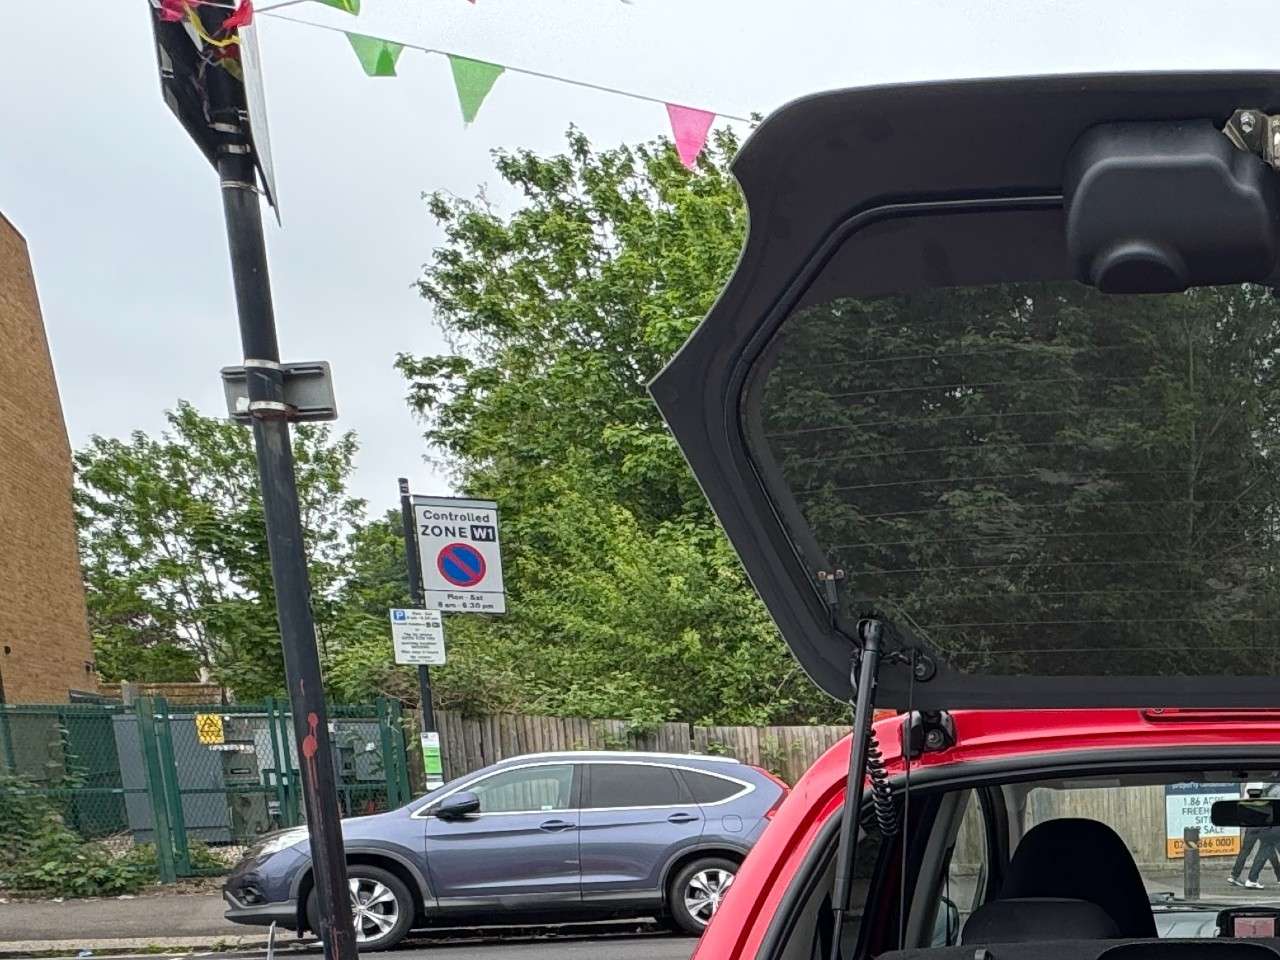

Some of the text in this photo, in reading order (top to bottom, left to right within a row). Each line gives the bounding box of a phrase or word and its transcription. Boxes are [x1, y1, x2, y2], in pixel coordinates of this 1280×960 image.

[423, 509, 490, 523] Controlled
[421, 524, 494, 540] ZONE W1
[1182, 807, 1210, 816] FREEH
[1195, 815, 1211, 824] SIT
